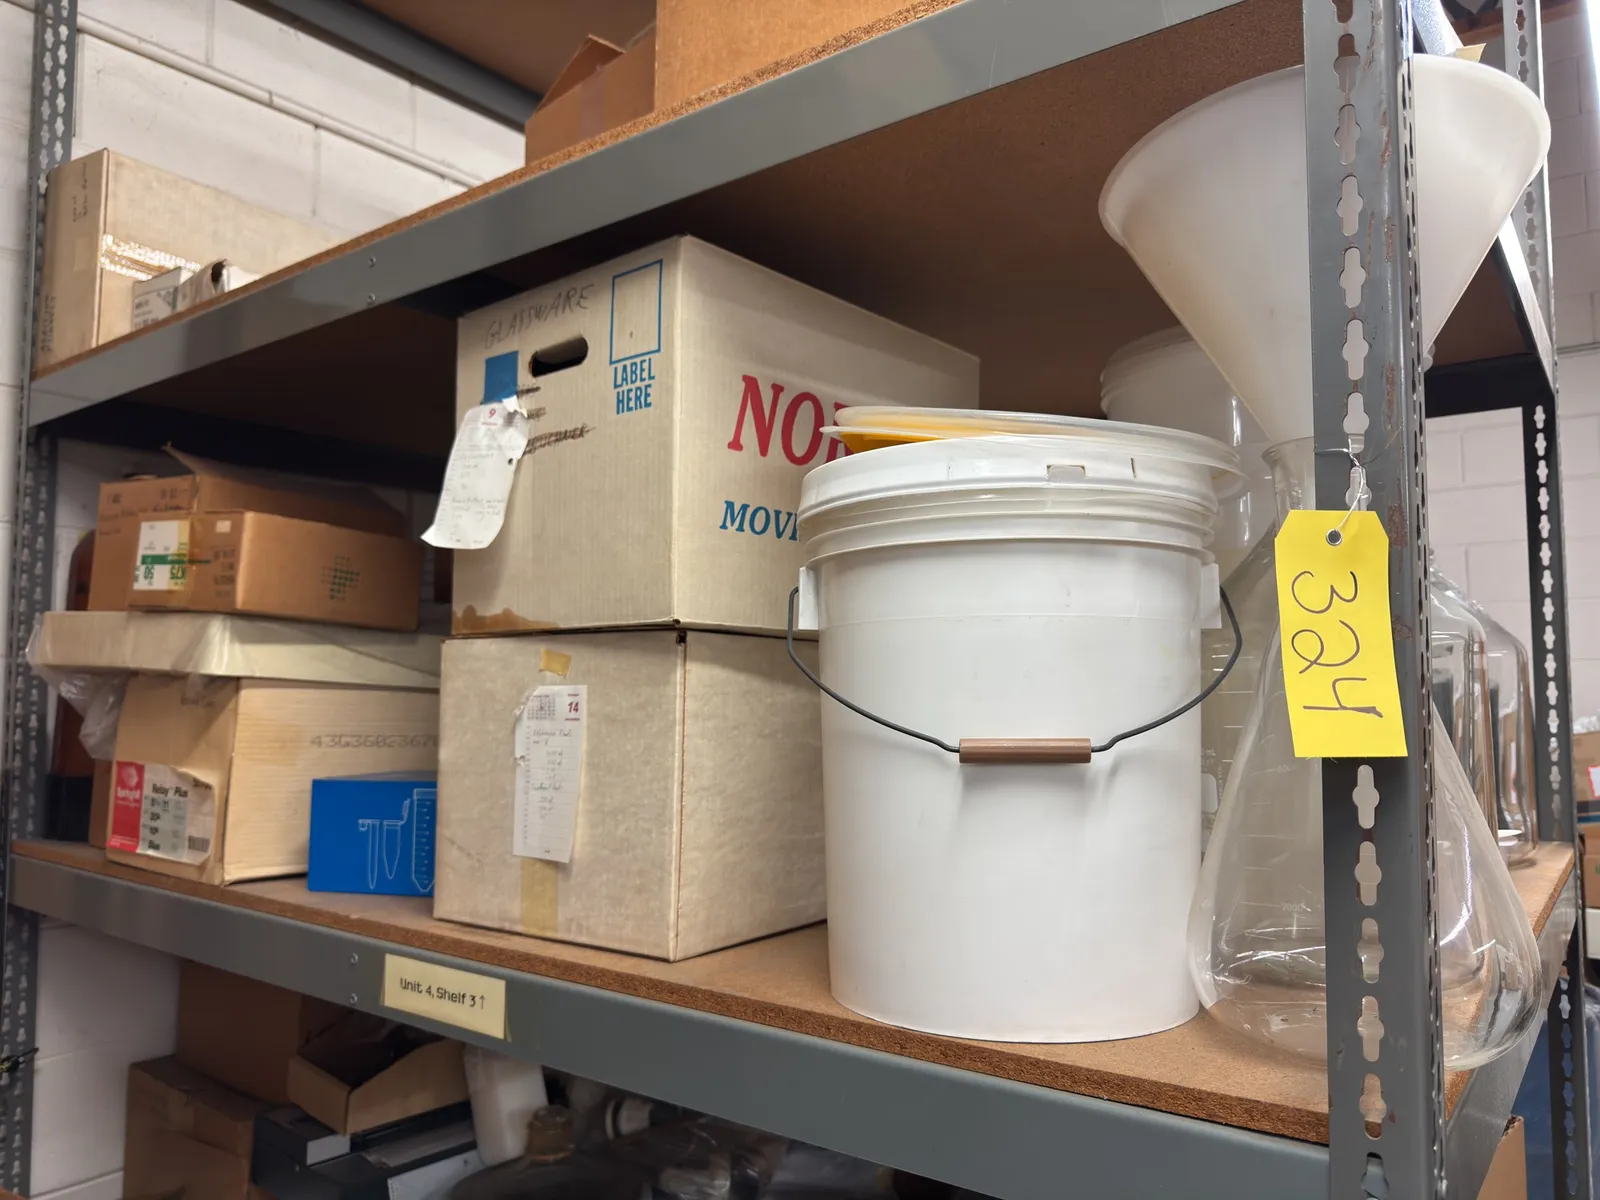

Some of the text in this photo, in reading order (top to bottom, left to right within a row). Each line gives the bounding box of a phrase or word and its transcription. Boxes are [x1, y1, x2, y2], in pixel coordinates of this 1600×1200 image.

[485, 284, 595, 349] GLASSWARE
[613, 358, 656, 389] LABEL
[488, 408, 497, 418] 9
[616, 383, 653, 415] HERE
[1291, 570, 1383, 718] 324
[567, 701, 579, 713] 14
[400, 977, 423, 994] Unit
[436, 986, 468, 1005] Shelf
[469, 994, 477, 1008] 3
